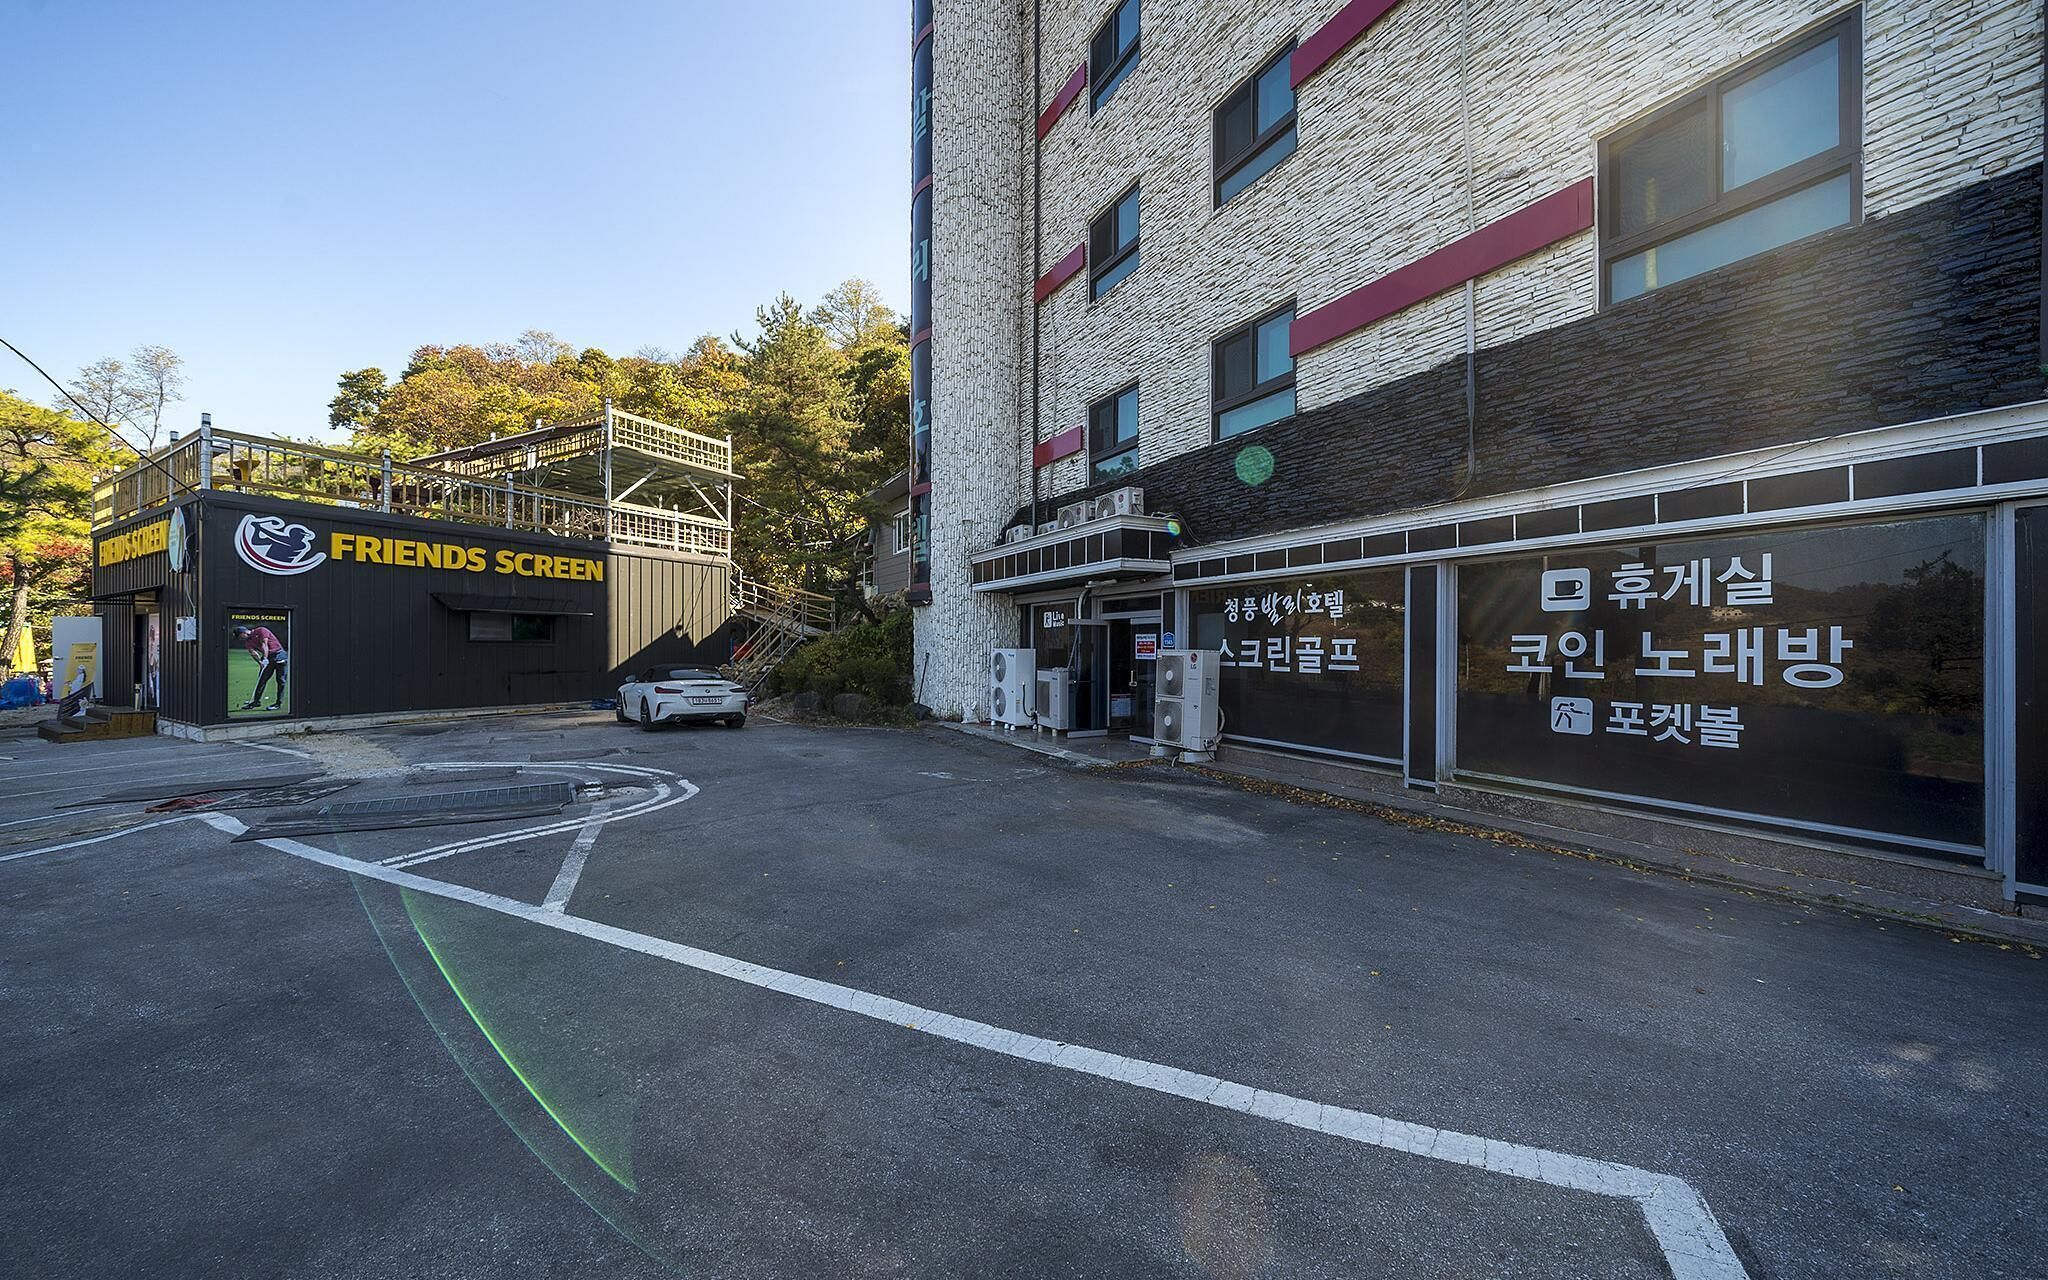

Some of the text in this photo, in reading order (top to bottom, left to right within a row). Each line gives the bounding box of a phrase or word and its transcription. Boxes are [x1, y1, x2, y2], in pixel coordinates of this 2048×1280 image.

[99, 532, 130, 567] FRIENDS
[131, 520, 170, 559] SCREEN
[330, 532, 604, 583] FRIENDS SCREEN
[1607, 552, 1773, 610] 휴게실
[1052, 611, 1065, 621] Live
[1219, 636, 1360, 675] 스크린골프
[1506, 625, 1854, 689] 코인 노래방
[1605, 700, 1745, 749] 포켓볼
